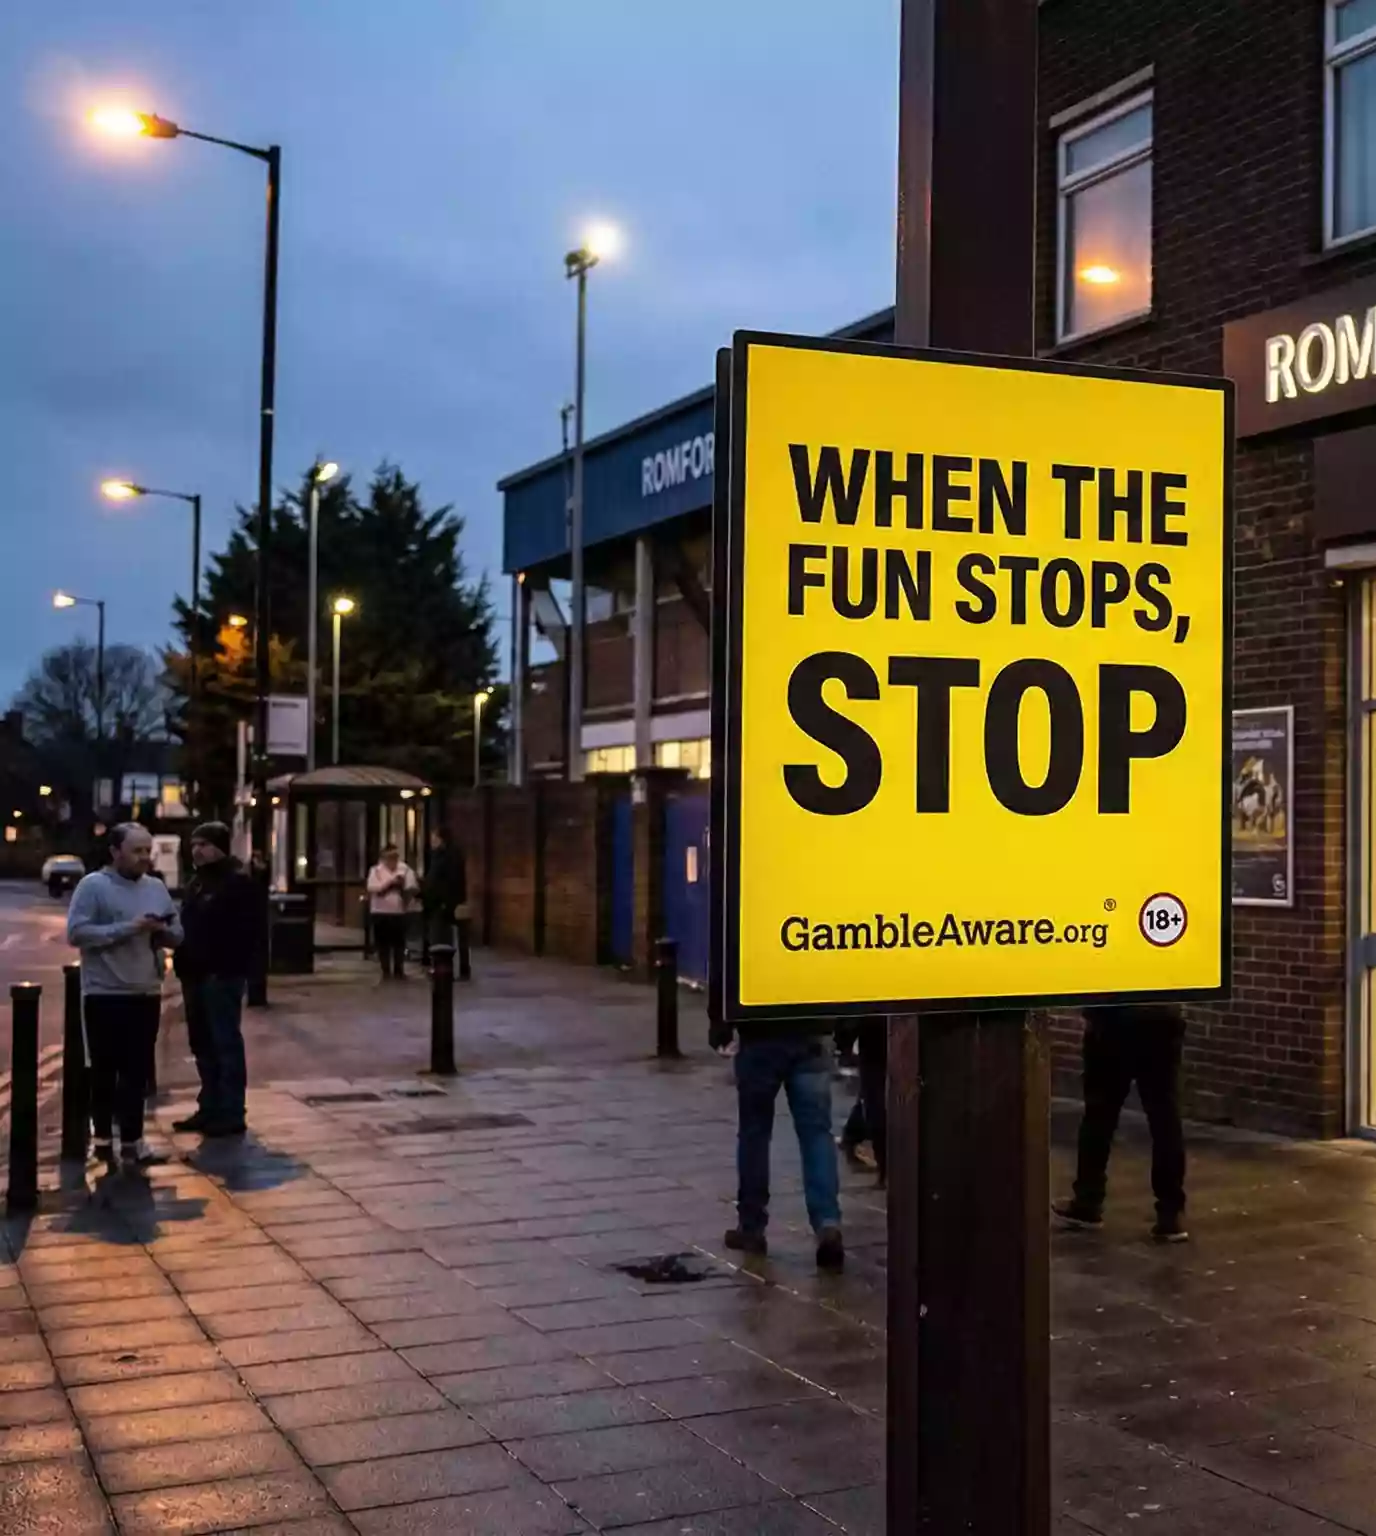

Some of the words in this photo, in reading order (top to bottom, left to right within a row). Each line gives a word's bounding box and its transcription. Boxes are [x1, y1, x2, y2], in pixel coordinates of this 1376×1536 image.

[788, 443, 1028, 536] WHEN
[1051, 463, 1189, 547] THE
[787, 543, 932, 621] FUN
[955, 552, 1191, 644] STOPS,
[783, 651, 1187, 817] STOP
[780, 913, 1110, 952] GambleAware.org
[1146, 909, 1182, 930] 18+
